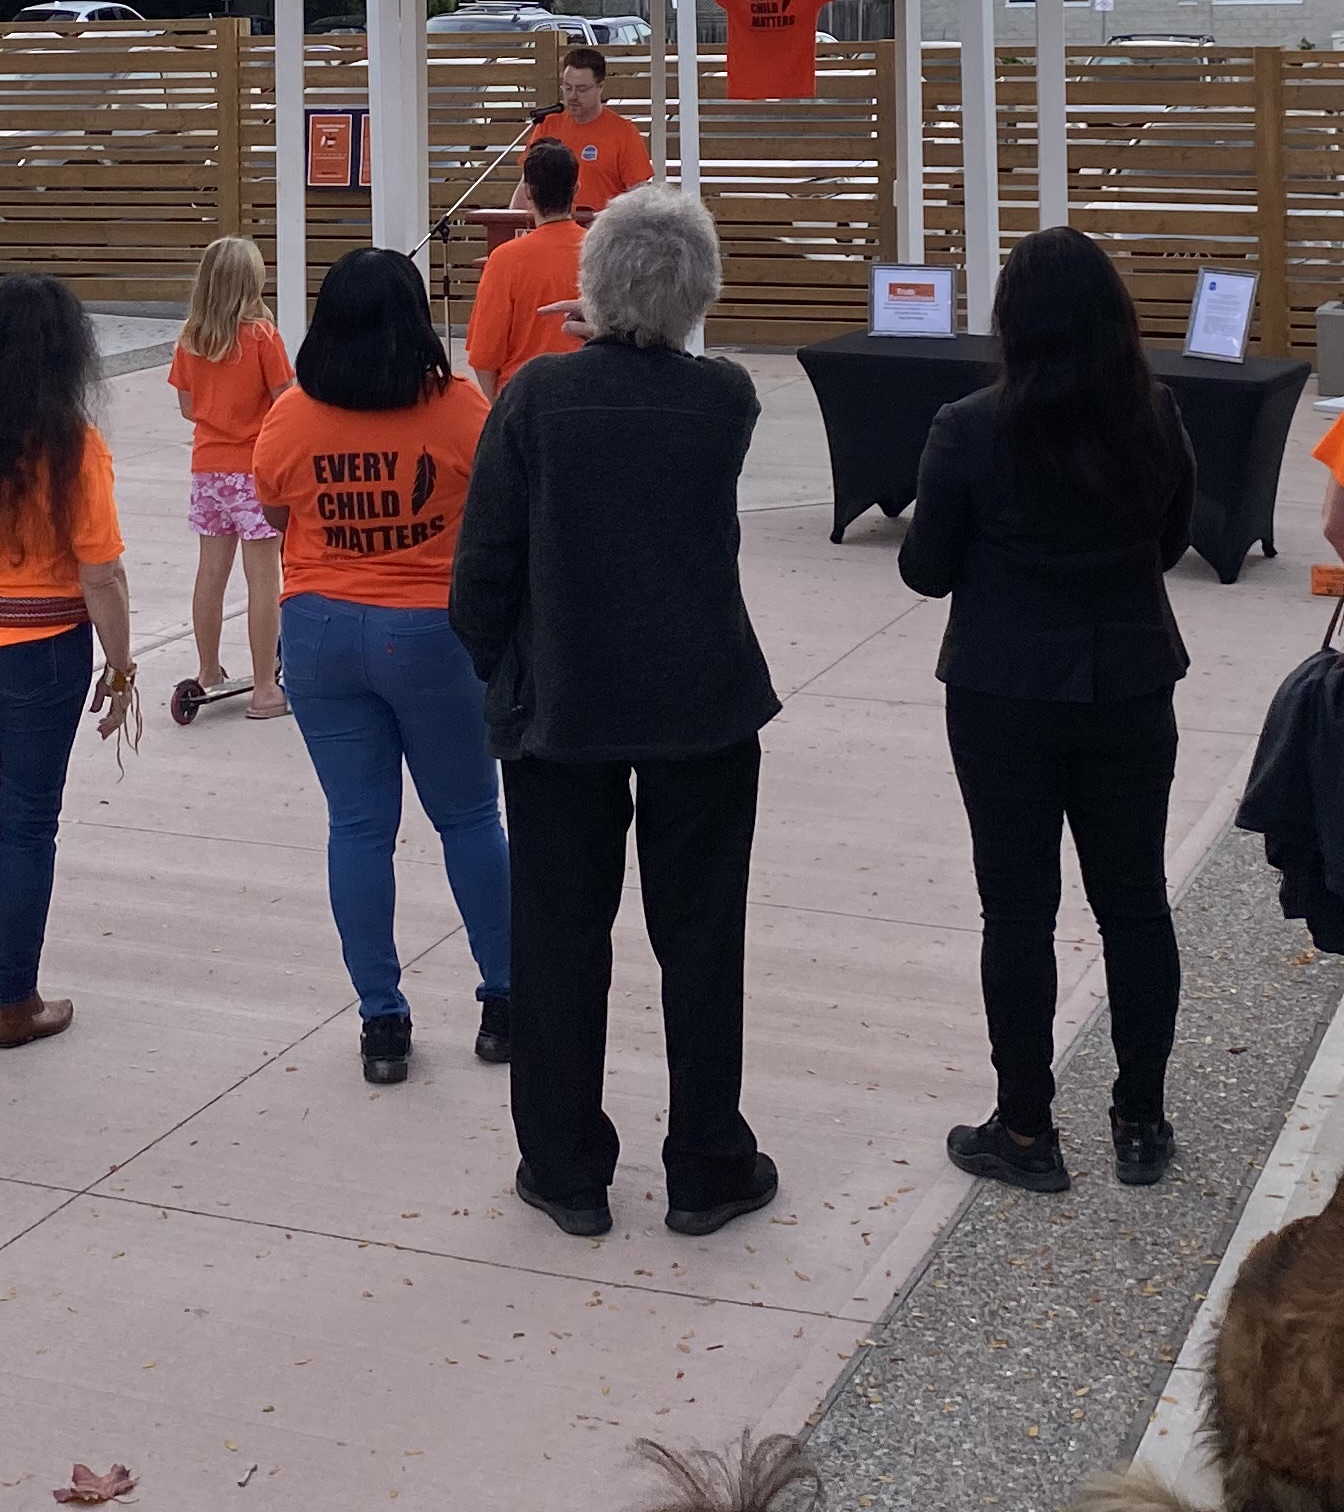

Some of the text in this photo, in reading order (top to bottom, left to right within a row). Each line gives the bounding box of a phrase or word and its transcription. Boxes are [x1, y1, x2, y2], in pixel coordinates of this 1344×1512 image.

[750, 2, 779, 14] CHILD
[752, 15, 795, 27] MATTERS
[313, 451, 399, 483] EVERY
[317, 490, 401, 520] CHILD
[321, 514, 446, 554] MATTERS
